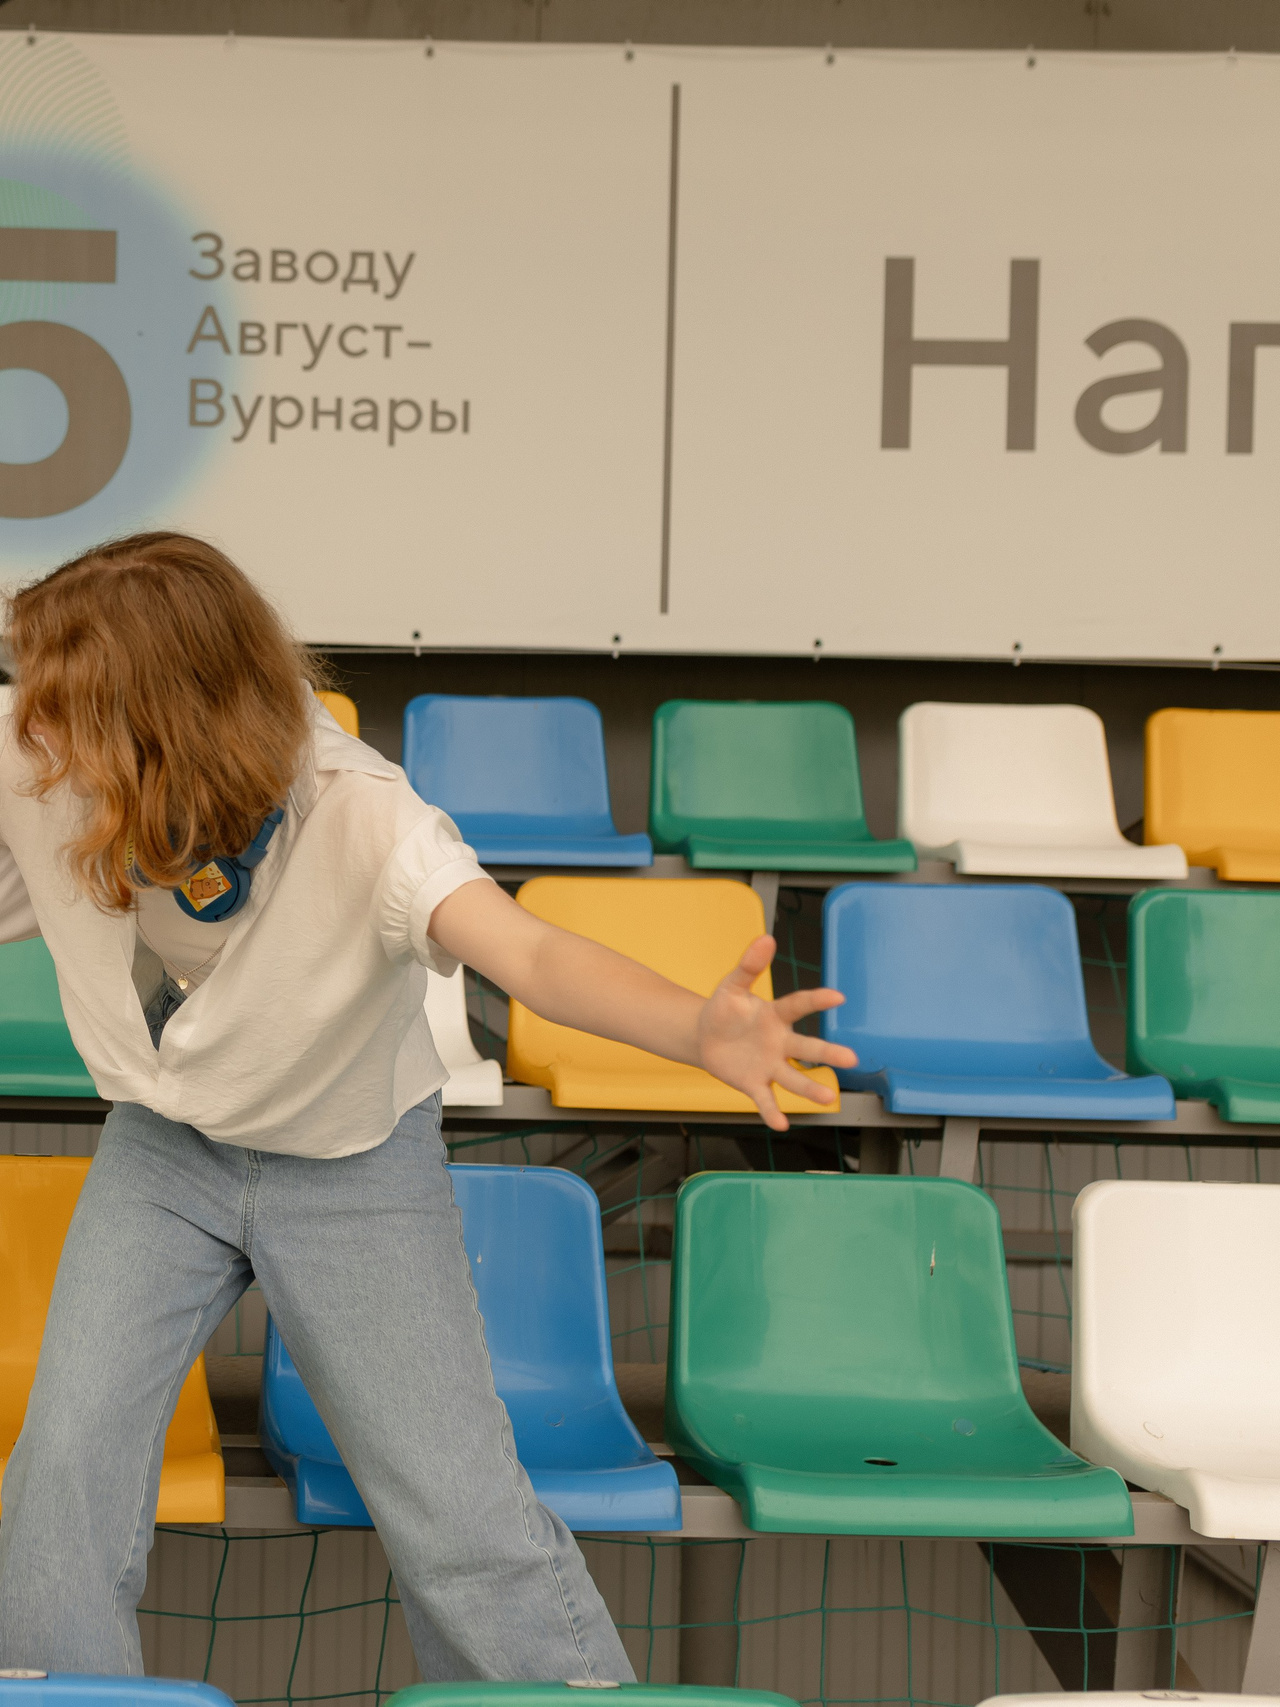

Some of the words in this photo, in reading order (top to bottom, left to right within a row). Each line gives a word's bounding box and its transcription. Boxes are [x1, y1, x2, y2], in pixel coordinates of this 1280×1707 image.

[187, 231, 416, 300] Заводу
[186, 305, 433, 371] Август-
[187, 378, 472, 447] Вурнары
